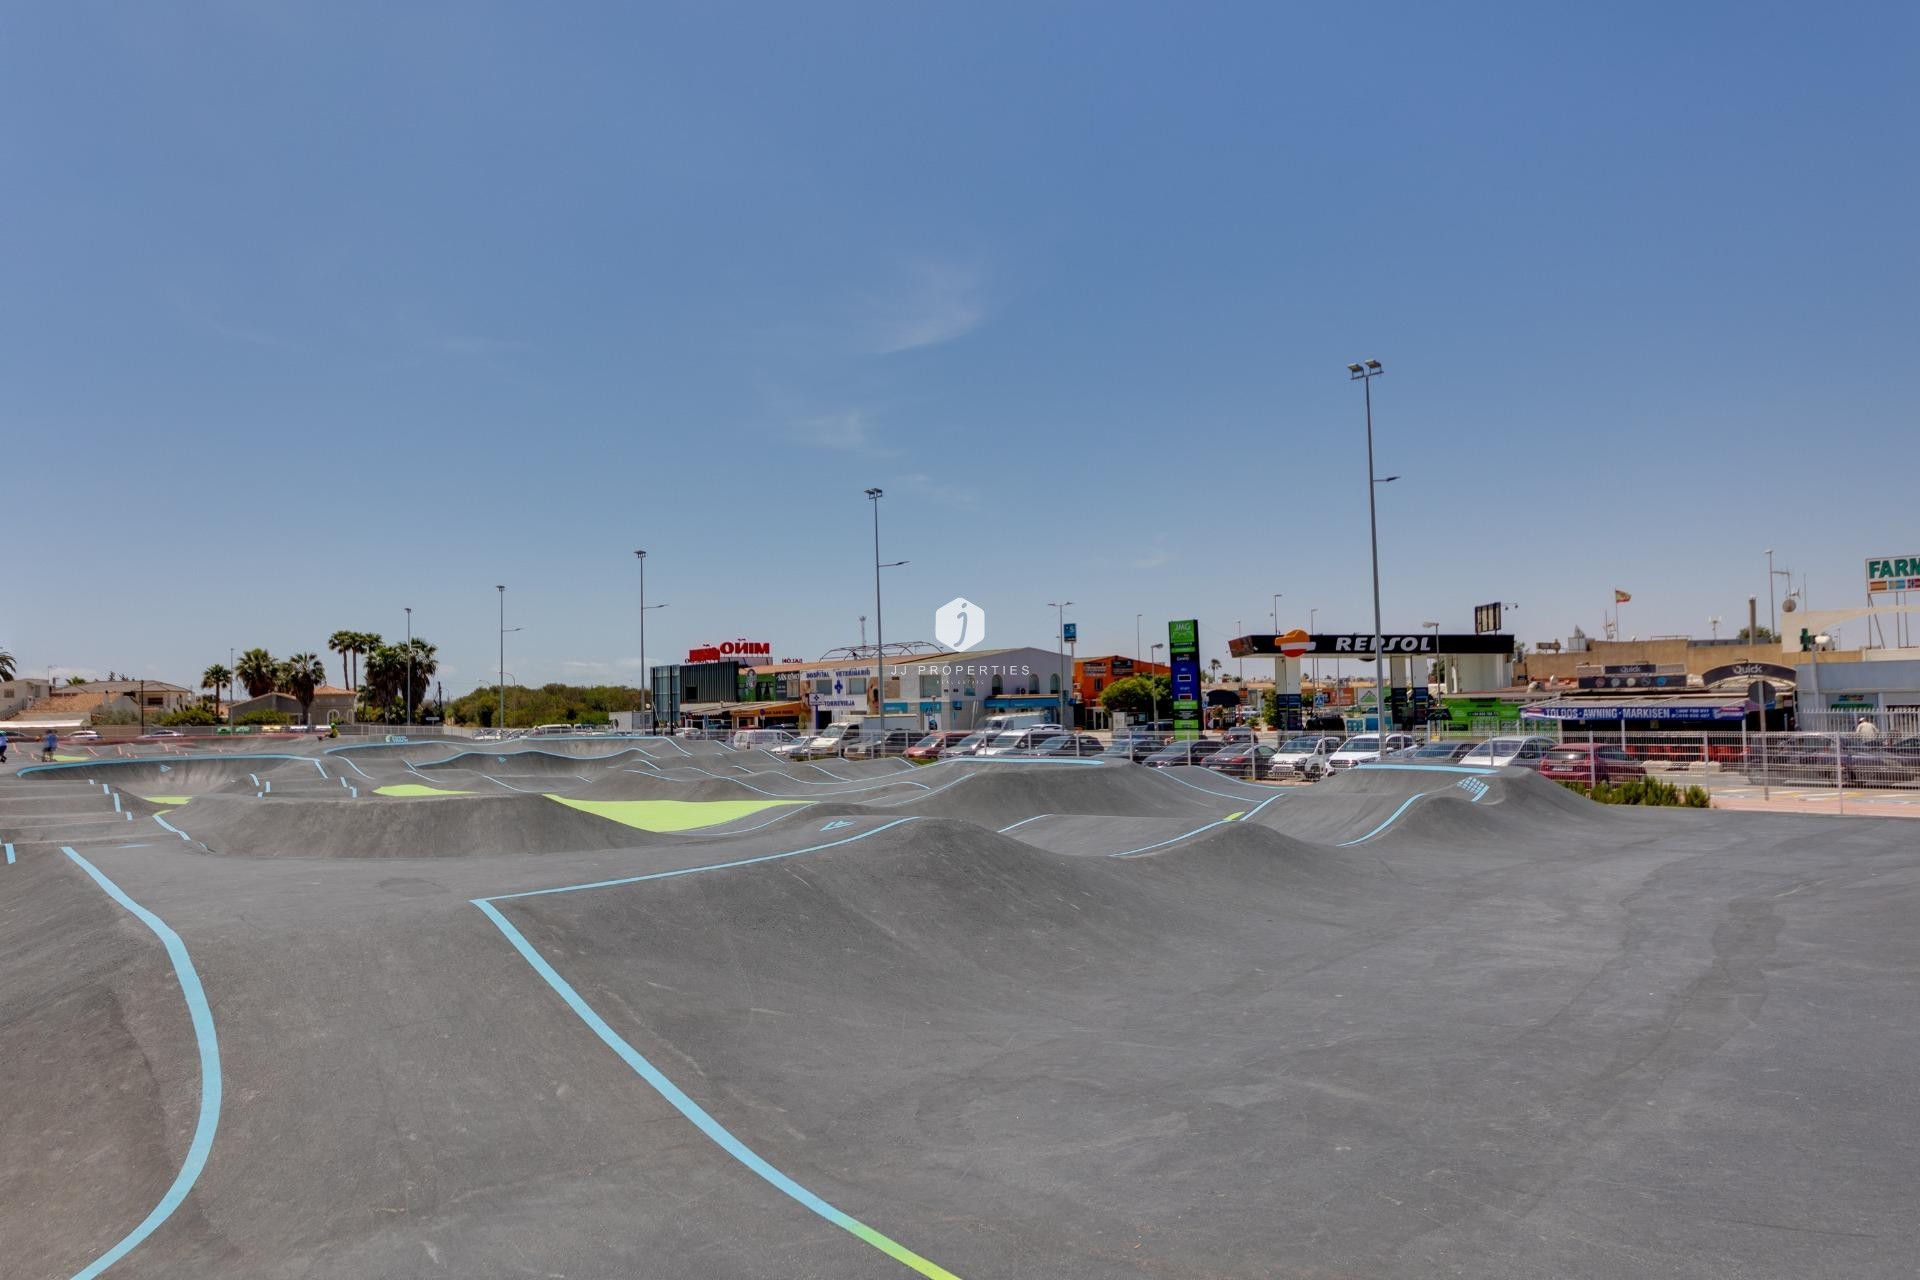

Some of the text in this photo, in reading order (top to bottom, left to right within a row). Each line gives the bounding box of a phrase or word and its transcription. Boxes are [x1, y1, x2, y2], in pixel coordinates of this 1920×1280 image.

[1335, 636, 1431, 652] REPSOL
[806, 670, 830, 679] HOSPITAL
[835, 668, 871, 678] VETERINARIO
[1620, 665, 1642, 674] Quick
[1732, 664, 1764, 675] Quick
[823, 700, 856, 708] TORREVIEJA
[1545, 708, 1578, 718] TOLDOS
[1582, 707, 1618, 719] AWNING
[1622, 707, 1670, 719] MARKISEN
